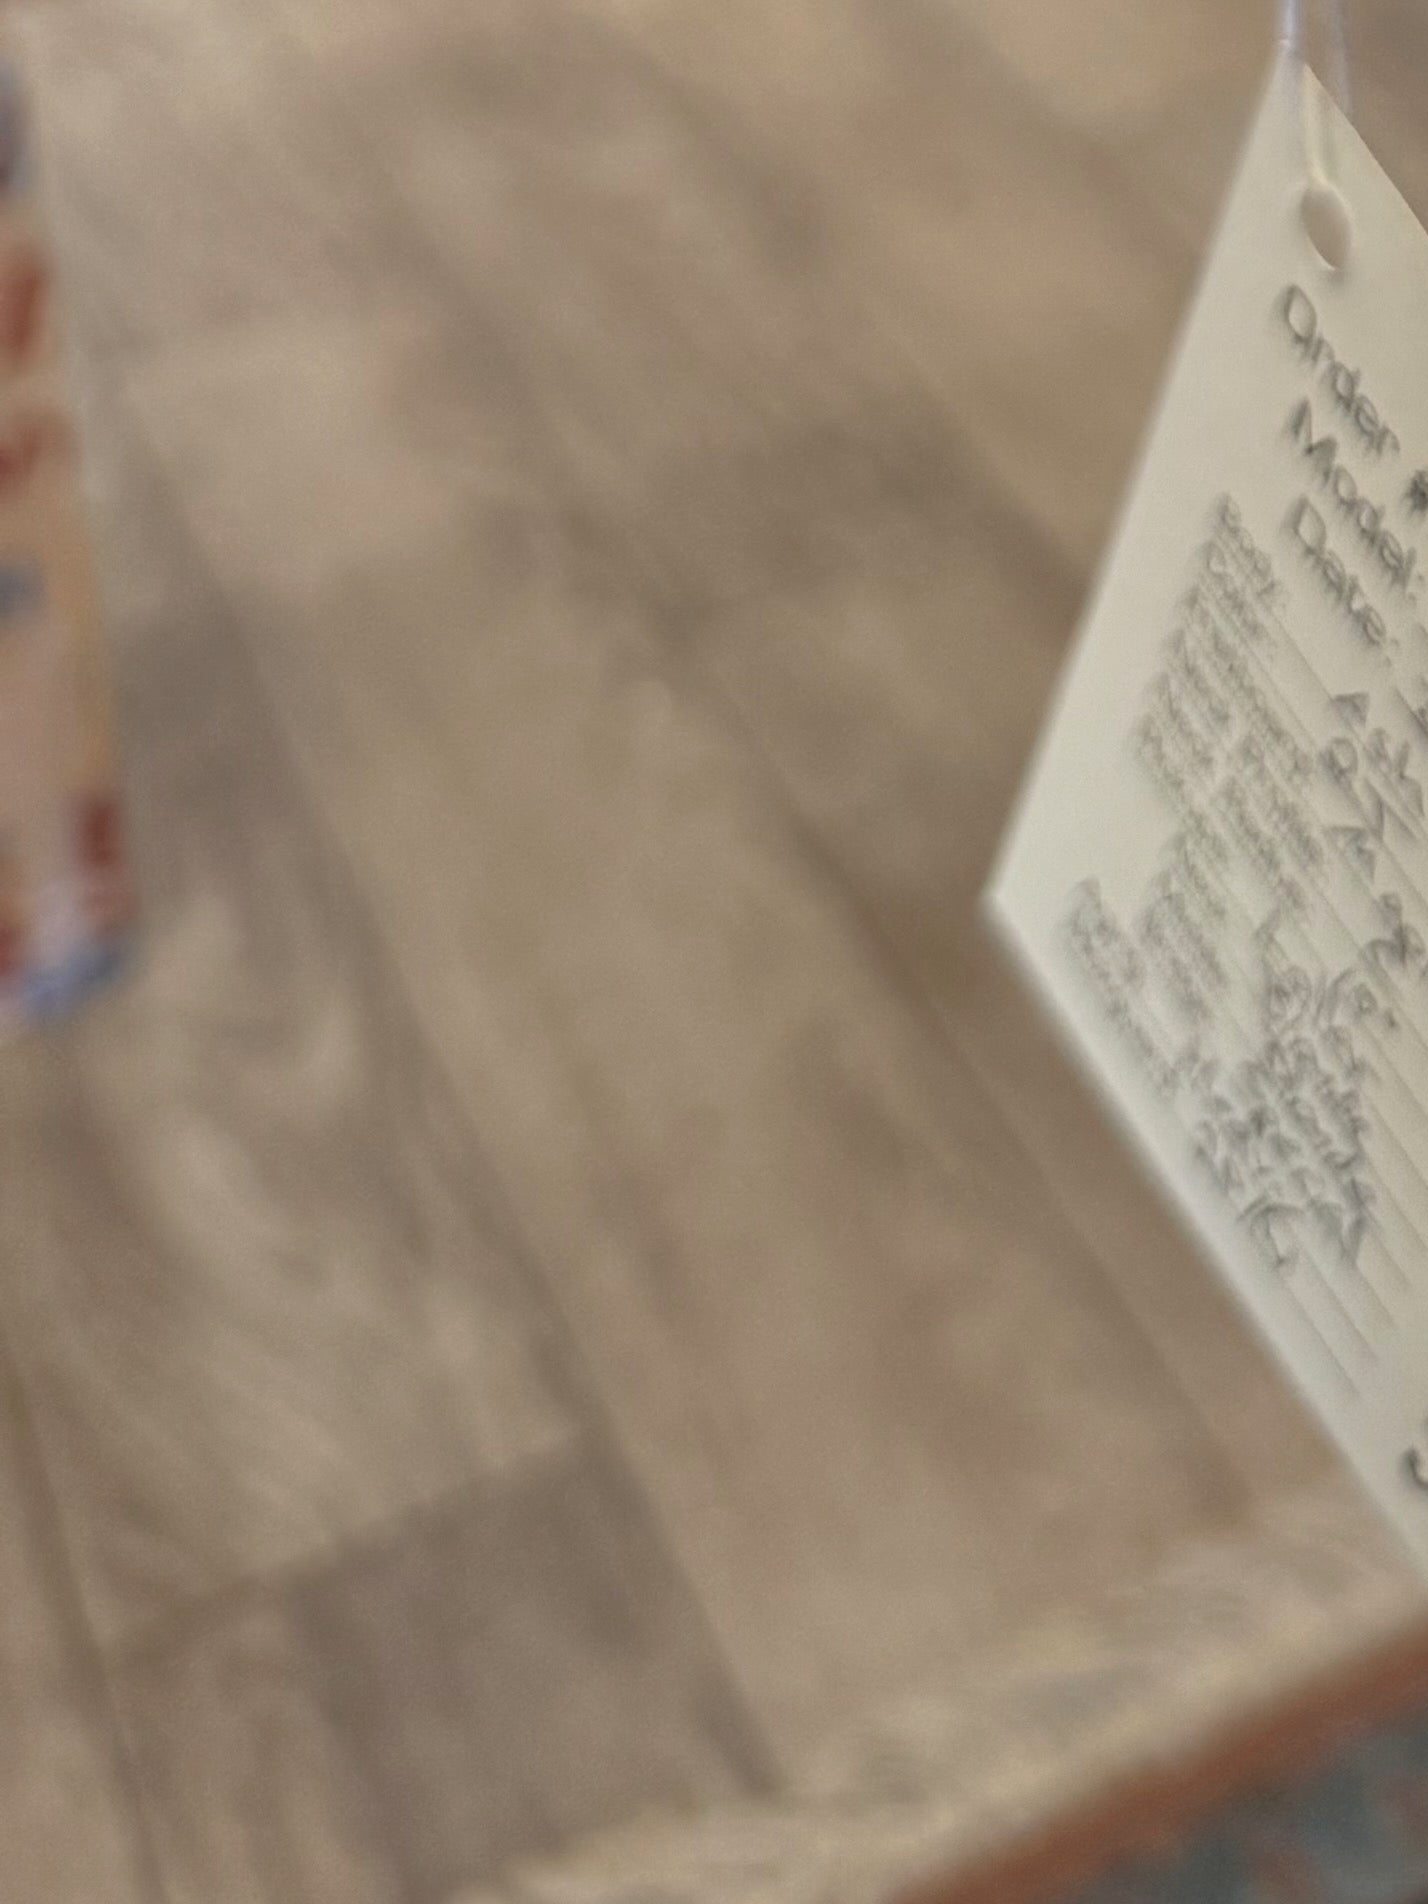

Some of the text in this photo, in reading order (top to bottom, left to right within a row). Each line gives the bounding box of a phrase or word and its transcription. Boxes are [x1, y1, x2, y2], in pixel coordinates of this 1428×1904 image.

[1274, 283, 1401, 456] Order
[1283, 399, 1418, 600] Model:
[1283, 496, 1392, 665] Date:
